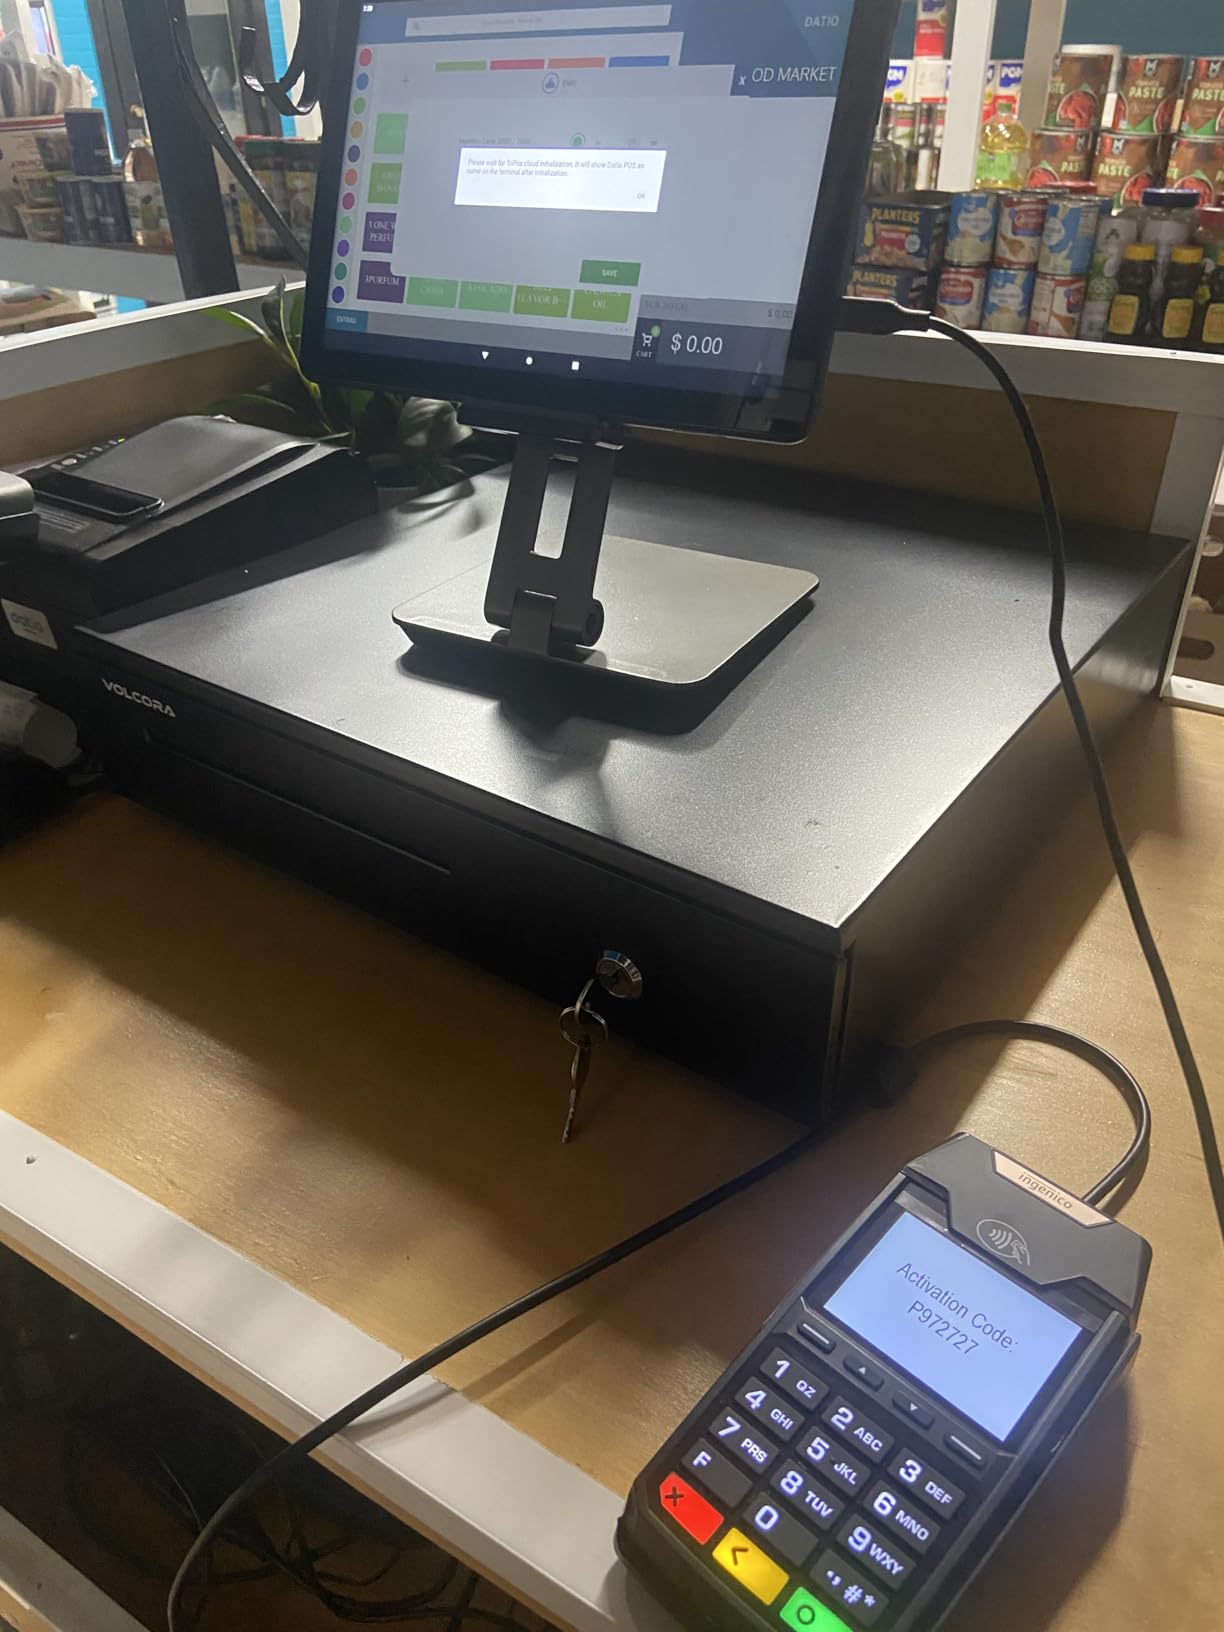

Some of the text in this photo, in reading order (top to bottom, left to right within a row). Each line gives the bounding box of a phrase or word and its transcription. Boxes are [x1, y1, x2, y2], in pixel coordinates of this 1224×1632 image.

[804, 16, 839, 27] DATIO
[778, 66, 837, 82] MARKET
[1128, 86, 1165, 98] PASTE
[524, 160, 539, 168] cloud
[1098, 164, 1132, 177] PASTE
[871, 208, 920, 224] PLANTERS
[602, 268, 618, 278] SAVE
[852, 270, 897, 287] PLANTERS
[636, 350, 652, 358] CART
[671, 332, 723, 355] $ 0.00
[102, 678, 176, 718] VOLCORA
[1018, 1173, 1072, 1210] ingenico
[896, 1263, 1019, 1353] Activation Code:
[908, 1300, 980, 1354] P972727
[775, 1359, 816, 1398] 1 QZ
[745, 1389, 794, 1430] 4 GHI
[718, 1416, 768, 1464] 7 PRS
[830, 1406, 883, 1452] 2 ABC
[692, 1451, 712, 1468] F
[806, 1436, 857, 1486] 5 JKL
[780, 1470, 834, 1518] 8 TUV
[899, 1459, 952, 1506] 3 DEF
[754, 1504, 780, 1530] 0
[873, 1491, 930, 1541] 6 MNO
[848, 1525, 904, 1576] 9 WXY
